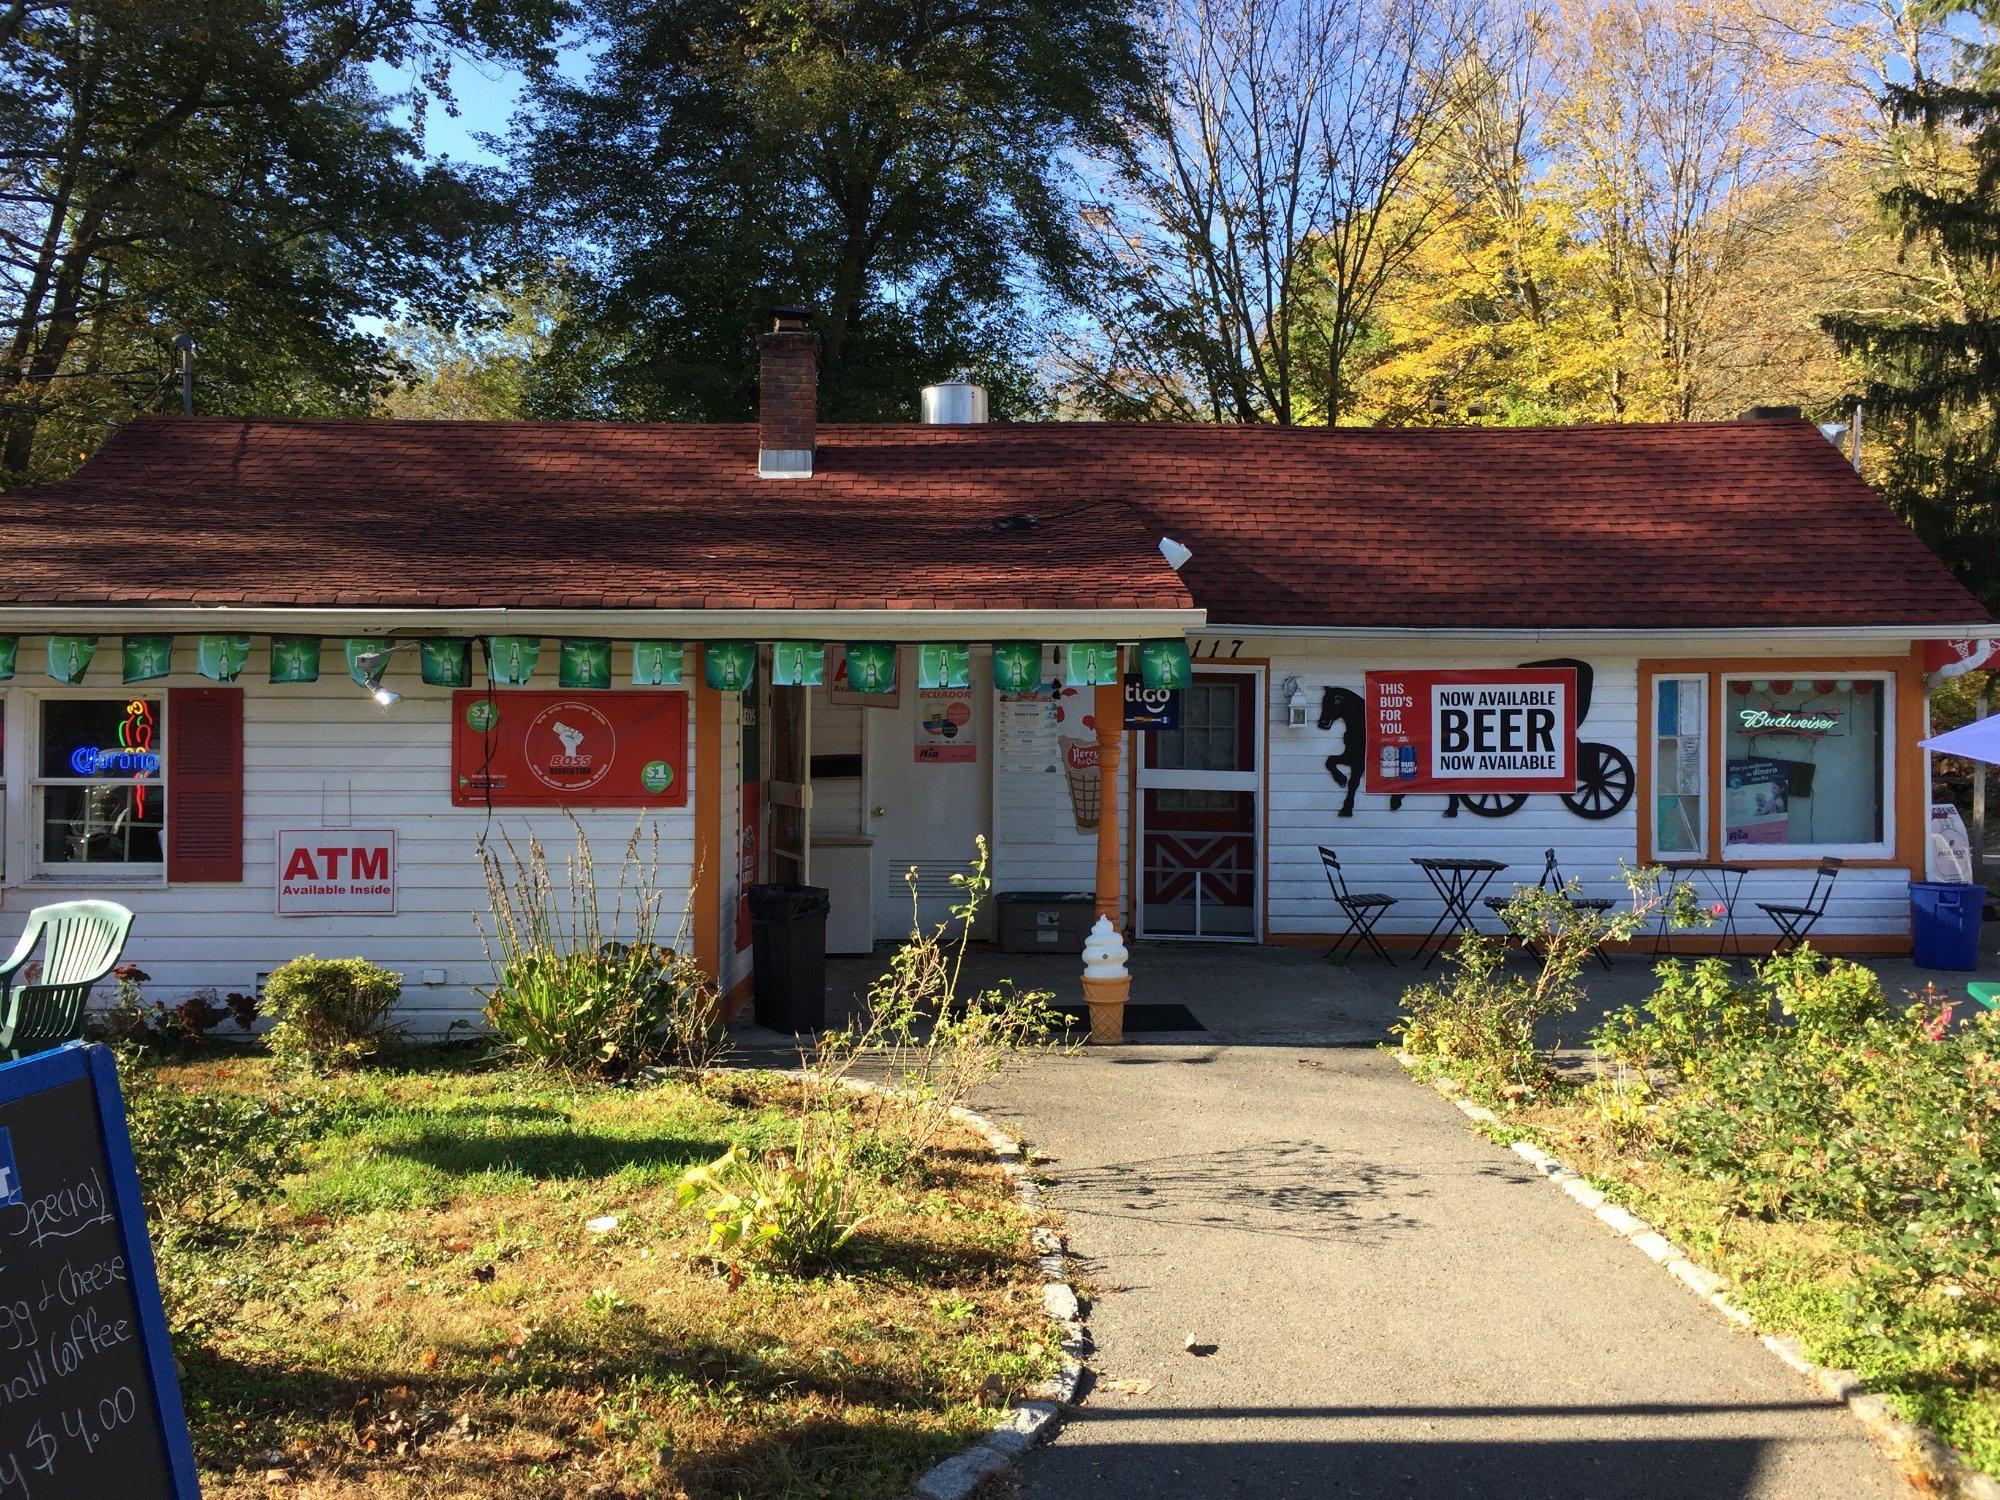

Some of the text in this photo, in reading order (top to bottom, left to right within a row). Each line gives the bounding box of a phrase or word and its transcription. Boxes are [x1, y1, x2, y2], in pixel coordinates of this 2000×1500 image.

[1191, 640, 1244, 659] 117
[919, 690, 972, 699] ECUADOR
[1379, 683, 1404, 695] THIS
[1380, 696, 1413, 708] BUD'S
[1440, 690, 1556, 707] NOW AVAILABLE
[1379, 709, 1402, 721] FOR
[1740, 710, 1839, 730] Budweiser
[1379, 722, 1406, 735] YOU.
[1440, 708, 1556, 753] BEER
[70, 747, 160, 774] Corona
[550, 754, 592, 767] BOSS
[1440, 755, 1556, 771] NOW AVAILABLE
[646, 764, 667, 779] $1
[282, 847, 389, 881] ATM
[283, 884, 391, 895] Available Inside
[8, 1166, 115, 1248] Special
[0, 1300, 38, 1350] gg
[58, 1255, 127, 1306] Cheese
[0, 1306, 132, 1404] all Coffee
